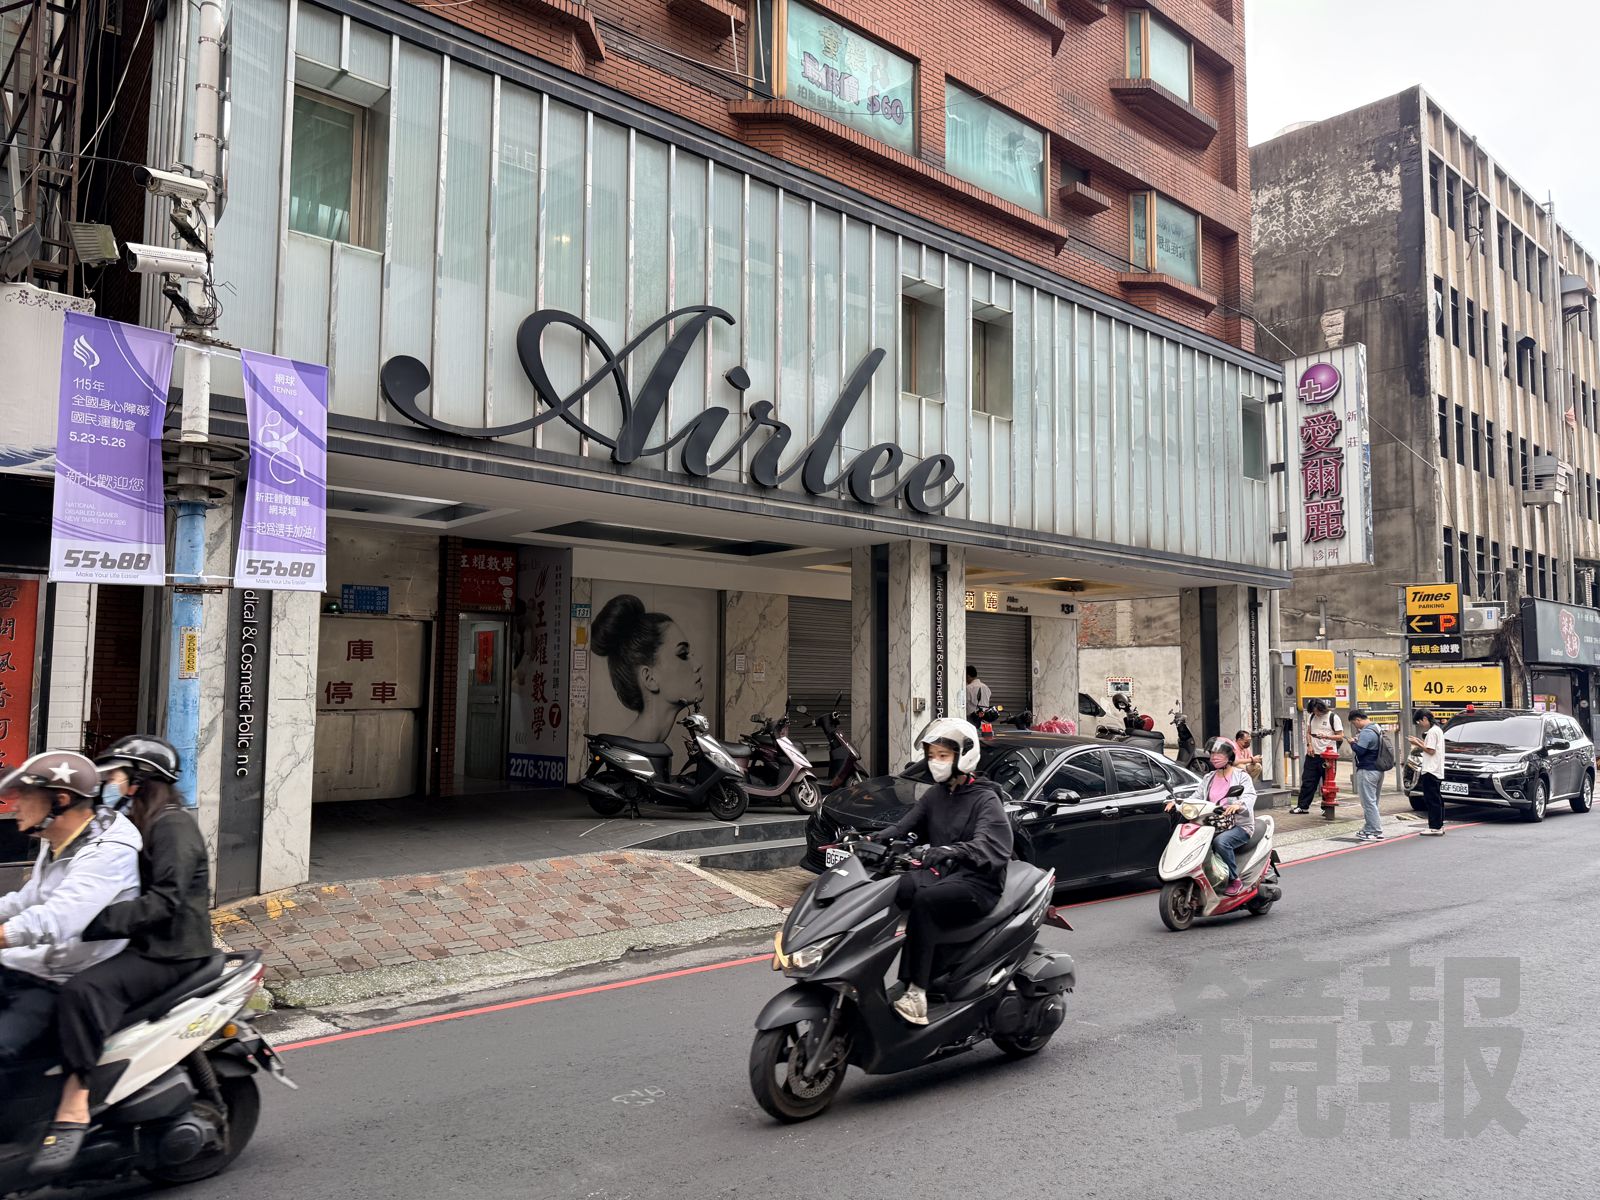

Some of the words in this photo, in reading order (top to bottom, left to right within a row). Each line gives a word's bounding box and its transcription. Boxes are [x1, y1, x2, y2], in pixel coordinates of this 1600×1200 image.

[73, 377, 105, 393] 115年
[273, 385, 298, 397] TENNIS
[71, 394, 151, 417] 全國身心障礙
[380, 304, 965, 514] Airlee
[70, 410, 137, 432] 國民運動會
[1346, 411, 1359, 449] 新莊
[69, 431, 126, 448] 5.23-5.26
[65, 469, 145, 492] 新北歡迎您
[1300, 411, 1346, 544] 愛爾麗
[64, 549, 152, 571] 55688
[1313, 547, 1339, 561] 診所
[246, 558, 316, 578] 55688
[1411, 591, 1452, 602] Times
[577, 608, 589, 617] 131
[242, 626, 258, 640] &
[936, 603, 944, 652] Biomedical
[346, 638, 375, 662] 庫
[1411, 643, 1460, 654] 無現金繳費
[239, 643, 257, 711] Cosmetic
[1304, 664, 1333, 683] Times
[936, 664, 944, 707] Cosmetic
[509, 757, 564, 782] 2276-3788
